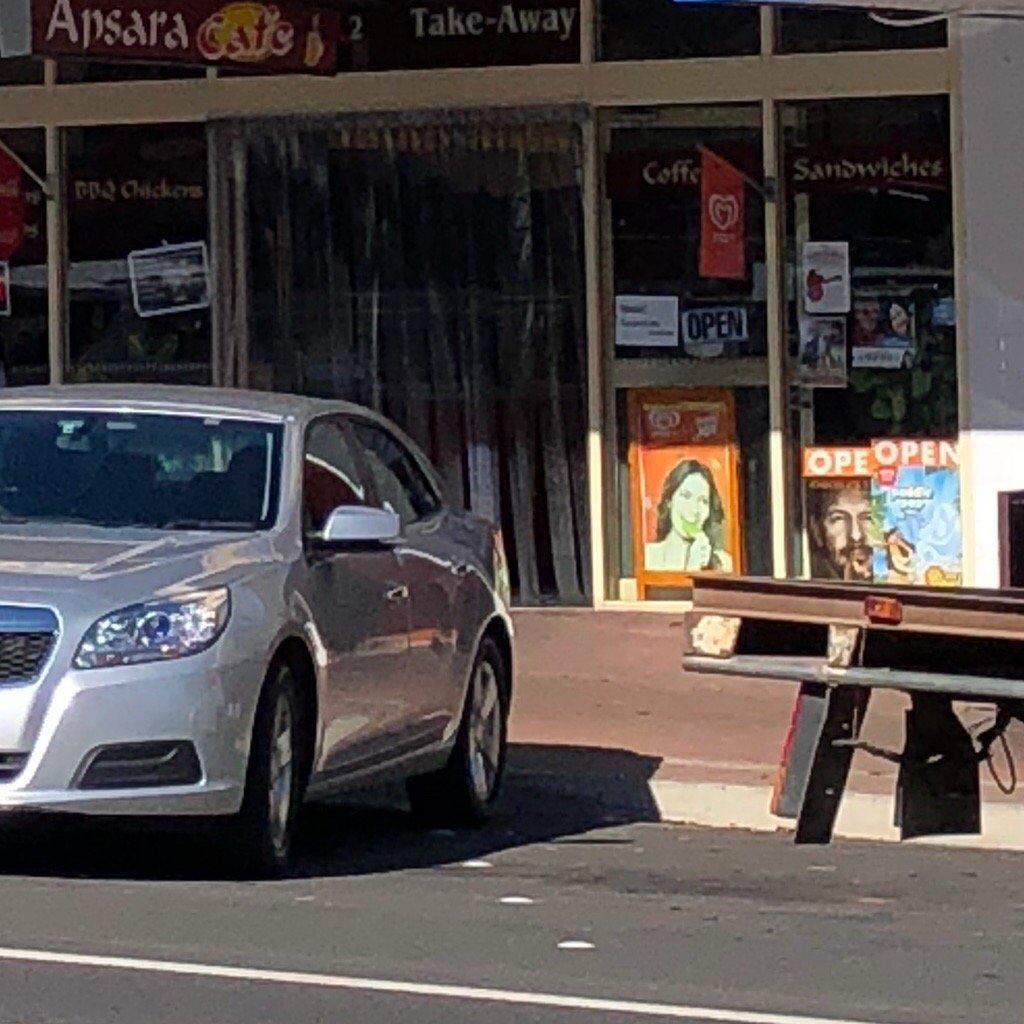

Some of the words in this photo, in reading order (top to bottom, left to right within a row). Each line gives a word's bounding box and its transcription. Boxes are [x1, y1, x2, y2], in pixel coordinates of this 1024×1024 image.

[410, 4, 576, 41] Take-Away
[792, 152, 944, 181] Sandwiches
[687, 310, 744, 341] OPEN
[807, 448, 870, 475] OPE
[874, 439, 959, 466] OPEN
